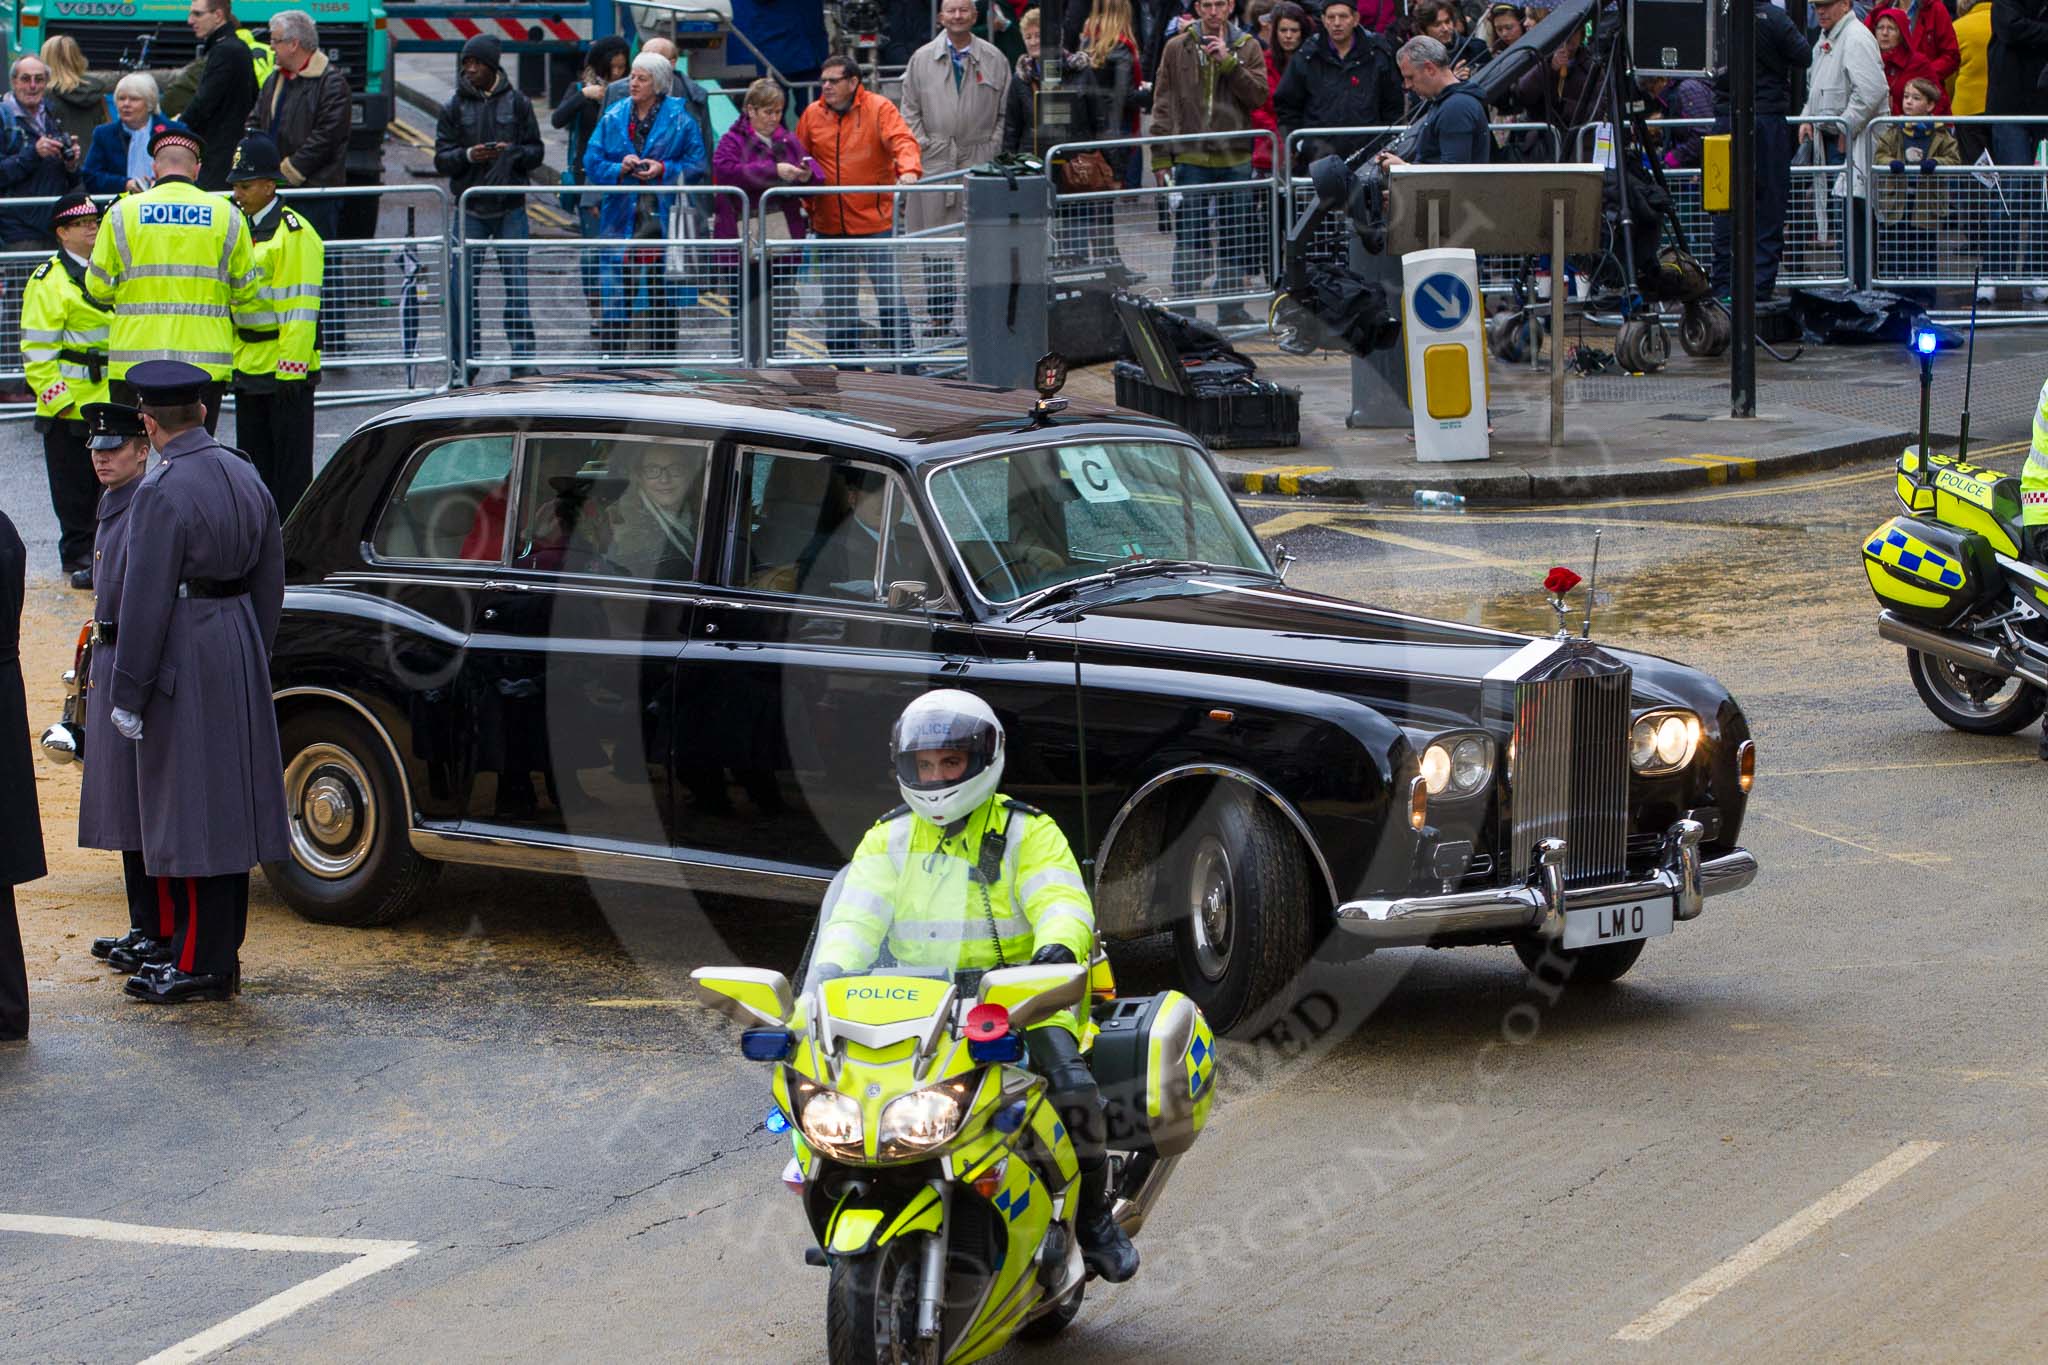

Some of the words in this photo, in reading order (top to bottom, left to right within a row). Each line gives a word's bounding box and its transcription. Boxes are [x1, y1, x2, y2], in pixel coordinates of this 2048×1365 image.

[55, 2, 137, 17] VOLVO
[141, 204, 211, 224] POLICE
[1081, 460, 1109, 491] C
[1939, 472, 1986, 497] POLICE
[845, 987, 919, 1001] POLICE
